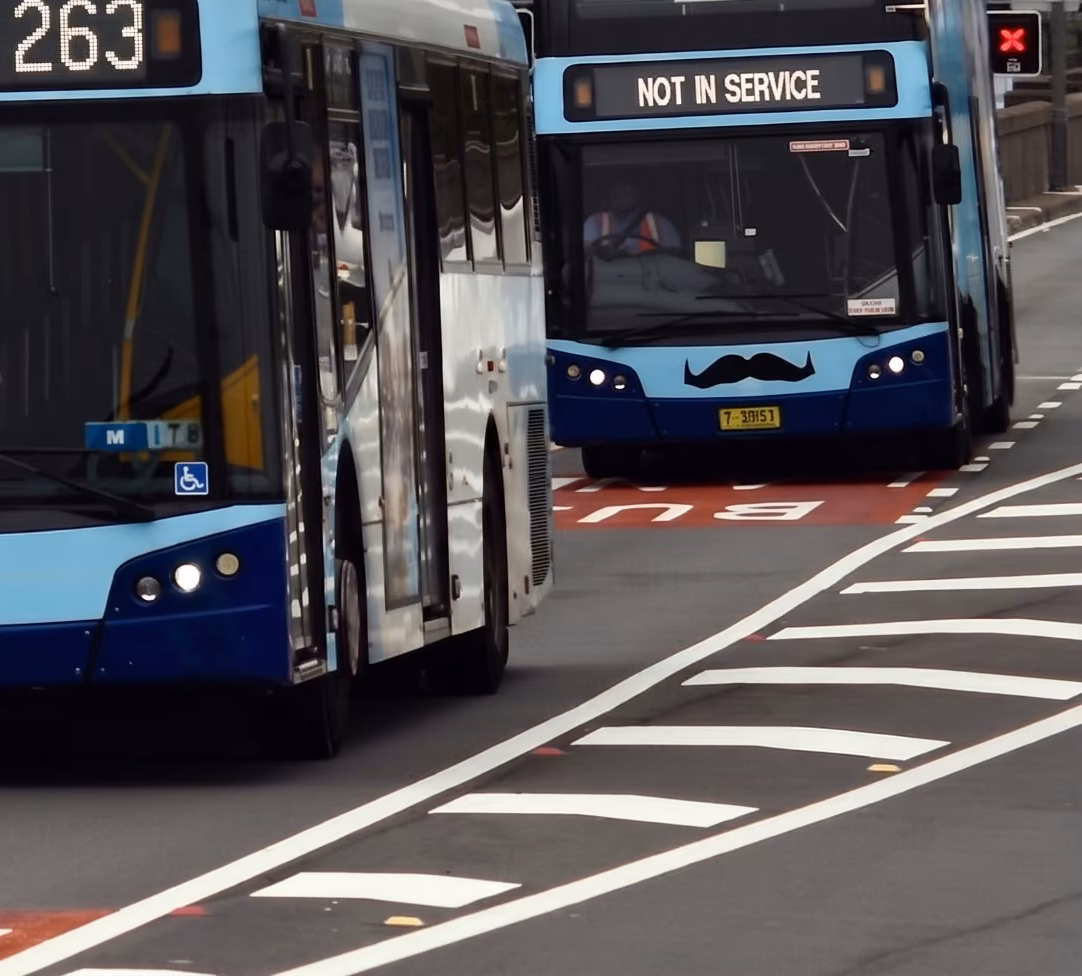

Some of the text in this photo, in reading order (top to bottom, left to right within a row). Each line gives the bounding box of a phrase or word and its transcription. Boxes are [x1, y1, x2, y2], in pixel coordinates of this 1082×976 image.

[637, 69, 821, 107] NOT IN SERVICE
[106, 429, 125, 445] M
[553, 500, 824, 522] BU
